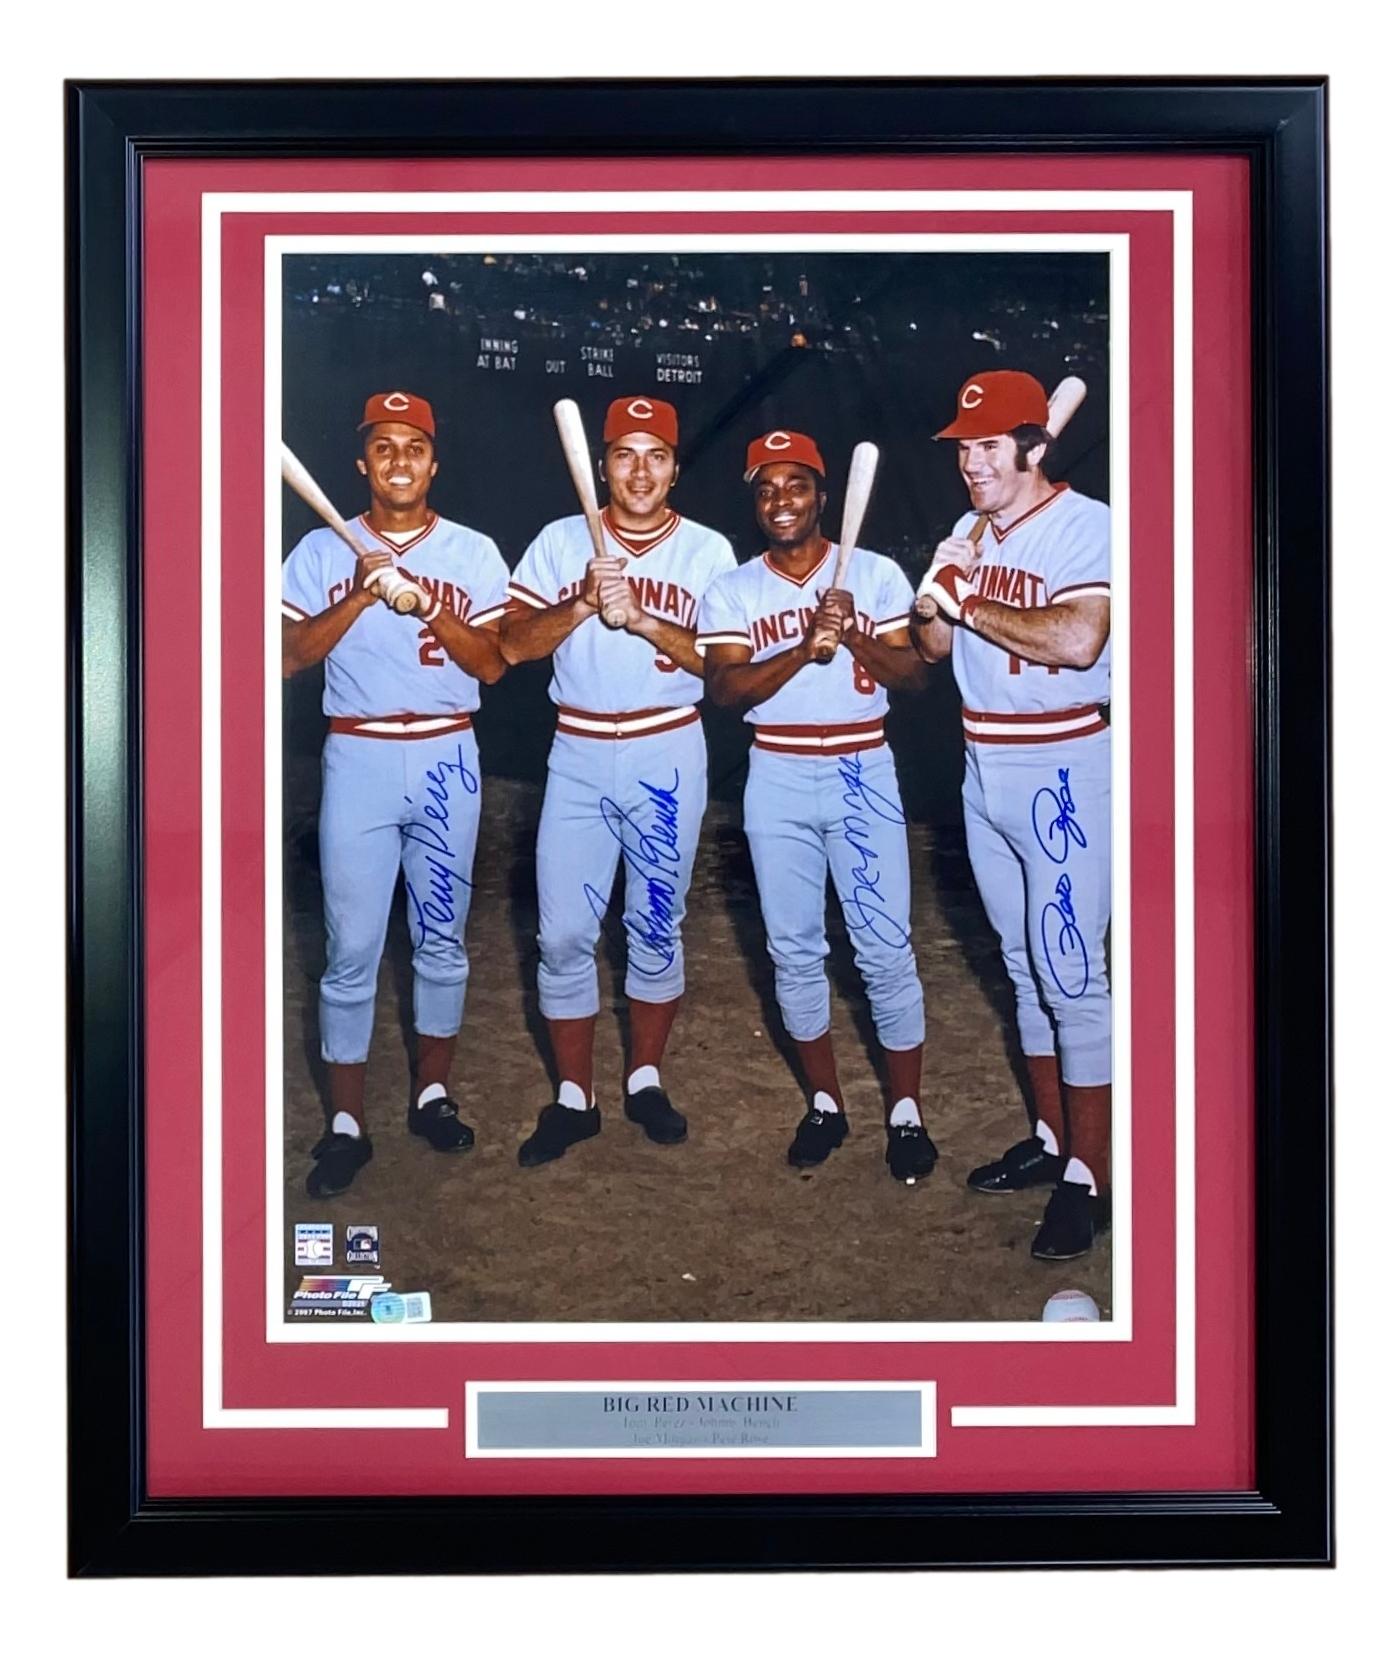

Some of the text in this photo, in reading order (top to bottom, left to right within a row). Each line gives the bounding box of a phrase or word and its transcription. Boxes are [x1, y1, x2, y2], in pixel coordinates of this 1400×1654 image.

[480, 338, 519, 354] INNING
[580, 346, 614, 362] STRIKE
[656, 353, 700, 367] VISITORS
[476, 354, 517, 370] AT BAT
[545, 360, 567, 373] OUT
[588, 363, 614, 378] BALL
[657, 368, 703, 383] DETROIT
[383, 393, 410, 411] C
[962, 384, 984, 409] C
[627, 400, 653, 419] C
[764, 431, 792, 450] C
[293, 1291, 357, 1299] Photo File
[314, 1308, 336, 1316] Photo
[603, 1397, 798, 1412] BIG RED MACHINE
